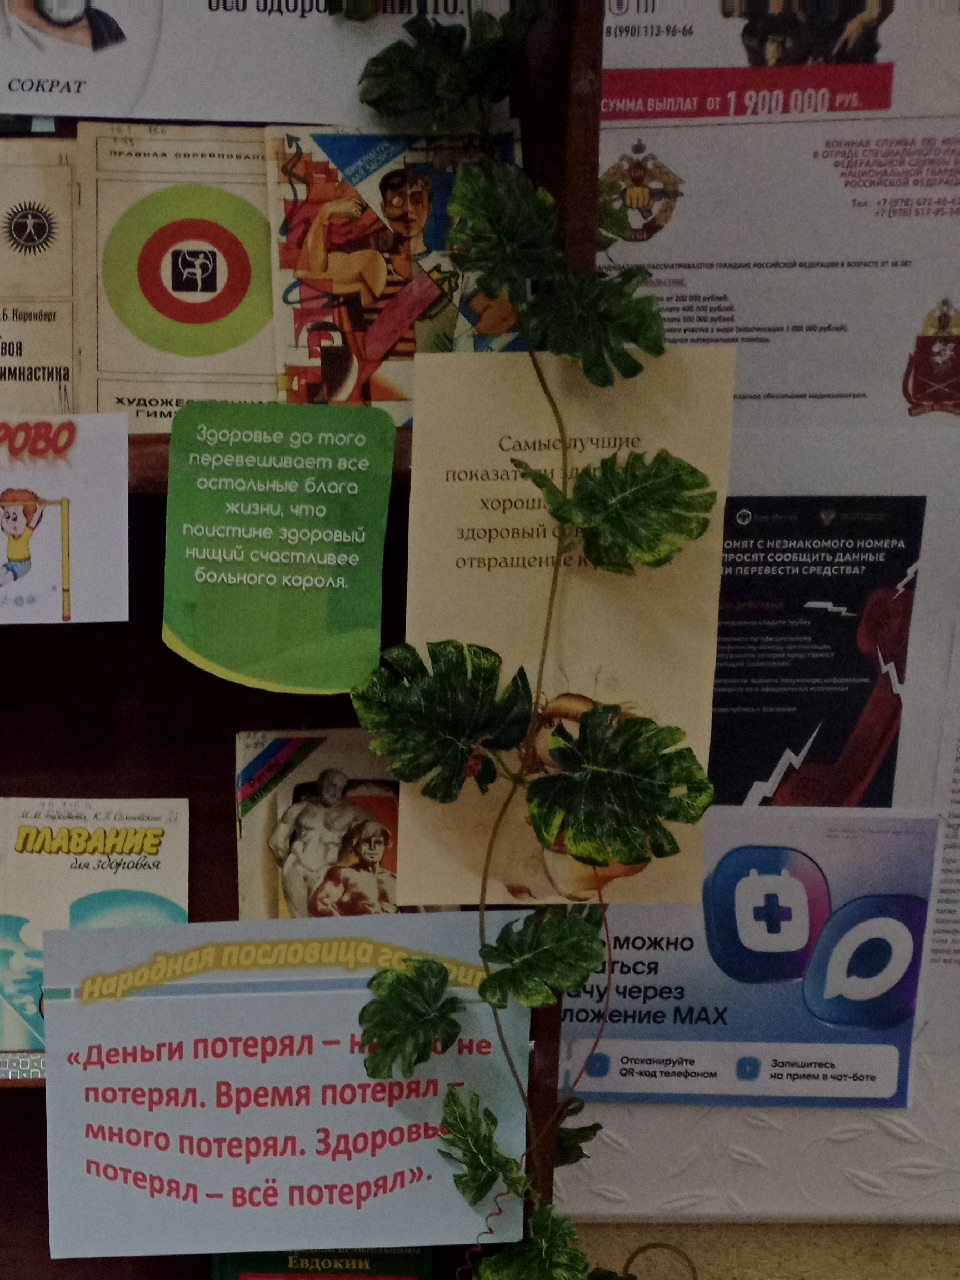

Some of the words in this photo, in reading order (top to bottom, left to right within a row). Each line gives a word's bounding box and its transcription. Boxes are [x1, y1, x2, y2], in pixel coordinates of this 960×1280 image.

[8, 78, 86, 94] СОКРАТ
[601, 98, 644, 112] СУММА
[648, 98, 698, 112] ВЫПЛАТ
[707, 98, 721, 110] ОТ
[727, 91, 736, 116] 1
[744, 90, 784, 115] 900
[791, 89, 829, 113] 000
[108, 150, 168, 159] ПРАВИЛА
[197, 424, 284, 447] Здоровье
[499, 436, 562, 451] Самые
[190, 453, 332, 470] перевешивает
[197, 477, 299, 493] остальные
[305, 477, 358, 494] блага
[183, 523, 273, 539] поистине
[279, 526, 366, 545] здоровый
[457, 524, 547, 543] здоровый
[767, 539, 854, 549] НЕЗНАКОМОГО
[857, 538, 906, 549] НОМЕРА
[767, 553, 834, 563] СООБЩИТЬ
[735, 567, 799, 575] ПЕРЕВЕСТИ
[801, 566, 866, 576] СРЕДСТВА?
[15, 825, 165, 856] ПЛАВАНИЕ
[93, 855, 161, 874] здоровья
[220, 939, 374, 970] пословица
[616, 985, 685, 1004] через
[561, 1009, 666, 1025] ложение
[193, 1033, 314, 1064] потерял
[620, 1056, 696, 1070] Отсканируйте
[771, 1059, 837, 1071] Запишитесь
[619, 1068, 657, 1080] QR-код
[660, 1069, 718, 1081] телефоном
[216, 1081, 311, 1116] Время
[320, 1079, 439, 1112] потерял
[85, 1120, 171, 1153] много
[86, 1157, 198, 1205] потерял
